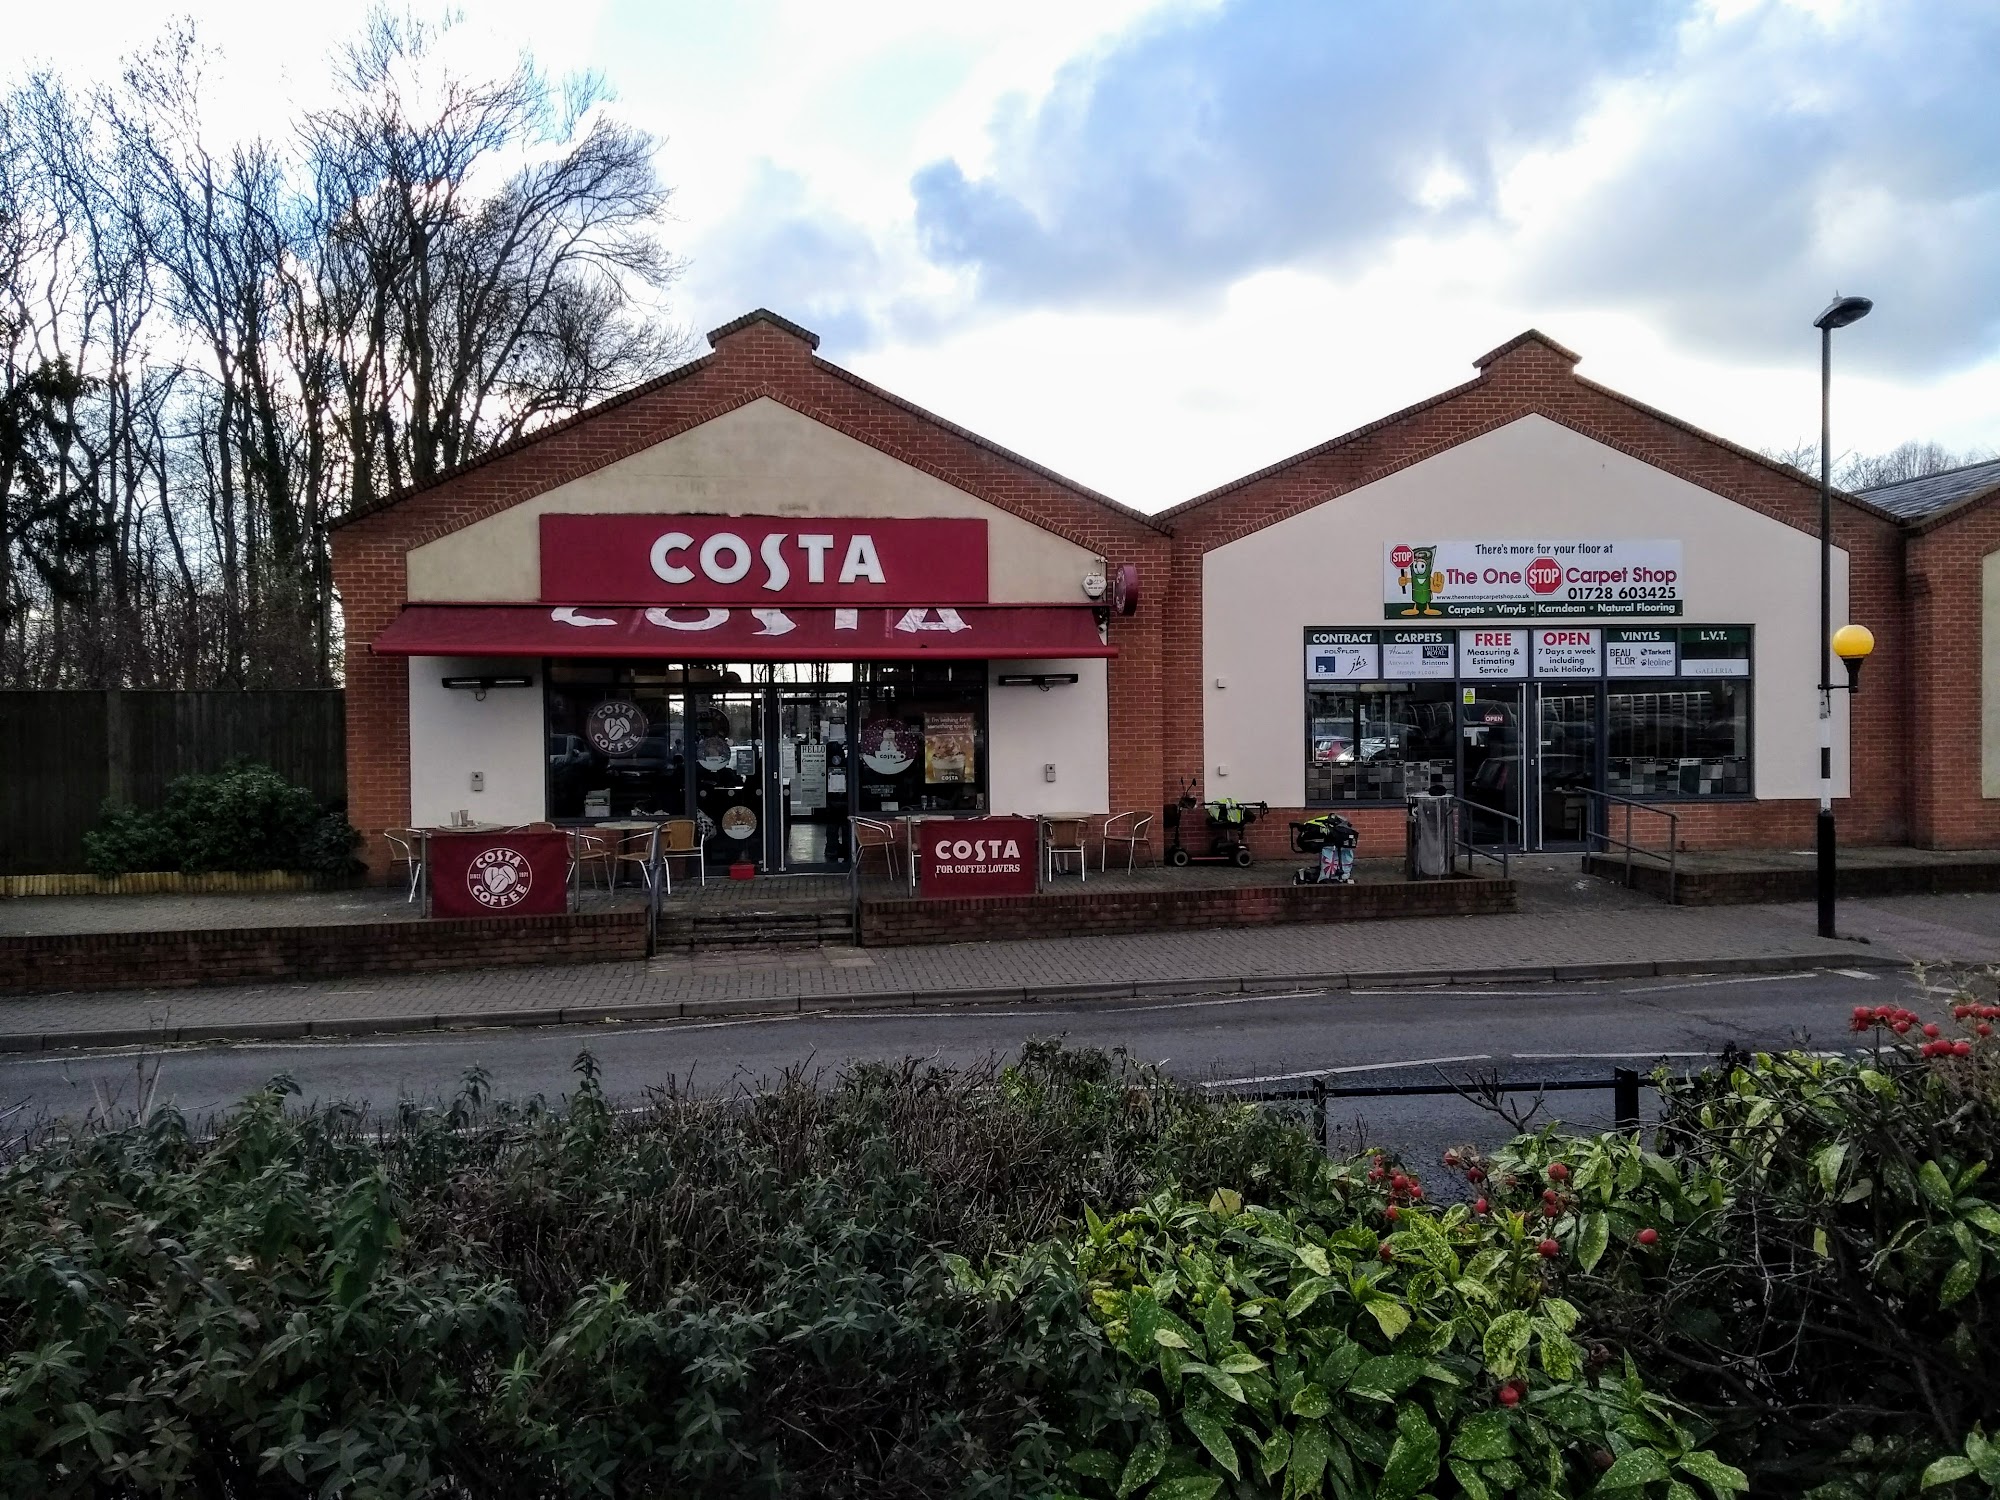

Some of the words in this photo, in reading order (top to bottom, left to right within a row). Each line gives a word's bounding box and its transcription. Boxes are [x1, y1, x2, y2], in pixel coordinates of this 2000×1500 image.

[1475, 544, 1508, 555] There's
[1537, 544, 1551, 554] for
[1554, 546, 1576, 556] your
[1578, 543, 1601, 554] floor
[1603, 544, 1614, 554] at
[650, 532, 886, 592] COSTA
[1392, 552, 1412, 563] STOP
[1446, 568, 1478, 585] The
[1483, 567, 1522, 585] One
[1528, 568, 1560, 585] STOP
[1565, 567, 1628, 586] Carpet
[1632, 566, 1677, 586] Shop
[1436, 593, 1530, 601] www.theonestopcarpetshop.co.uk
[1568, 587, 1613, 600] 01728
[1618, 586, 1676, 600] 603425
[1447, 605, 1485, 616] Carpets
[1496, 604, 1527, 616] Vinyls
[1538, 603, 1586, 613] Karndean
[1597, 603, 1634, 613] Natural
[1637, 602, 1676, 614] Flooring
[1312, 633, 1373, 643] CONTRACT
[1394, 632, 1443, 643] CARPETS
[1475, 632, 1512, 647] FREE
[1543, 631, 1590, 646] OPEN
[1621, 631, 1660, 641] VINYLS
[1700, 631, 1728, 641] L.V.T.
[1467, 648, 1511, 658] Measuring
[1513, 648, 1520, 656] &
[1545, 648, 1565, 657] Days
[1609, 649, 1631, 657] BEAU
[1648, 648, 1671, 656] Tarkett
[1472, 657, 1515, 666] Estimating
[1549, 656, 1585, 666] including
[1615, 656, 1636, 666] FLOR
[1561, 665, 1596, 674] Holidays
[1695, 667, 1733, 675] GALLERIA
[597, 704, 635, 719] COSTA
[594, 733, 640, 752] COFFEE
[802, 745, 825, 753] HELLO
[935, 840, 1021, 862] COSTA
[476, 850, 522, 869] COSTA
[936, 865, 953, 874] FOR
[954, 864, 986, 874] COFFEE
[988, 864, 1021, 873] LOVERS
[472, 884, 528, 906] COFFEE
